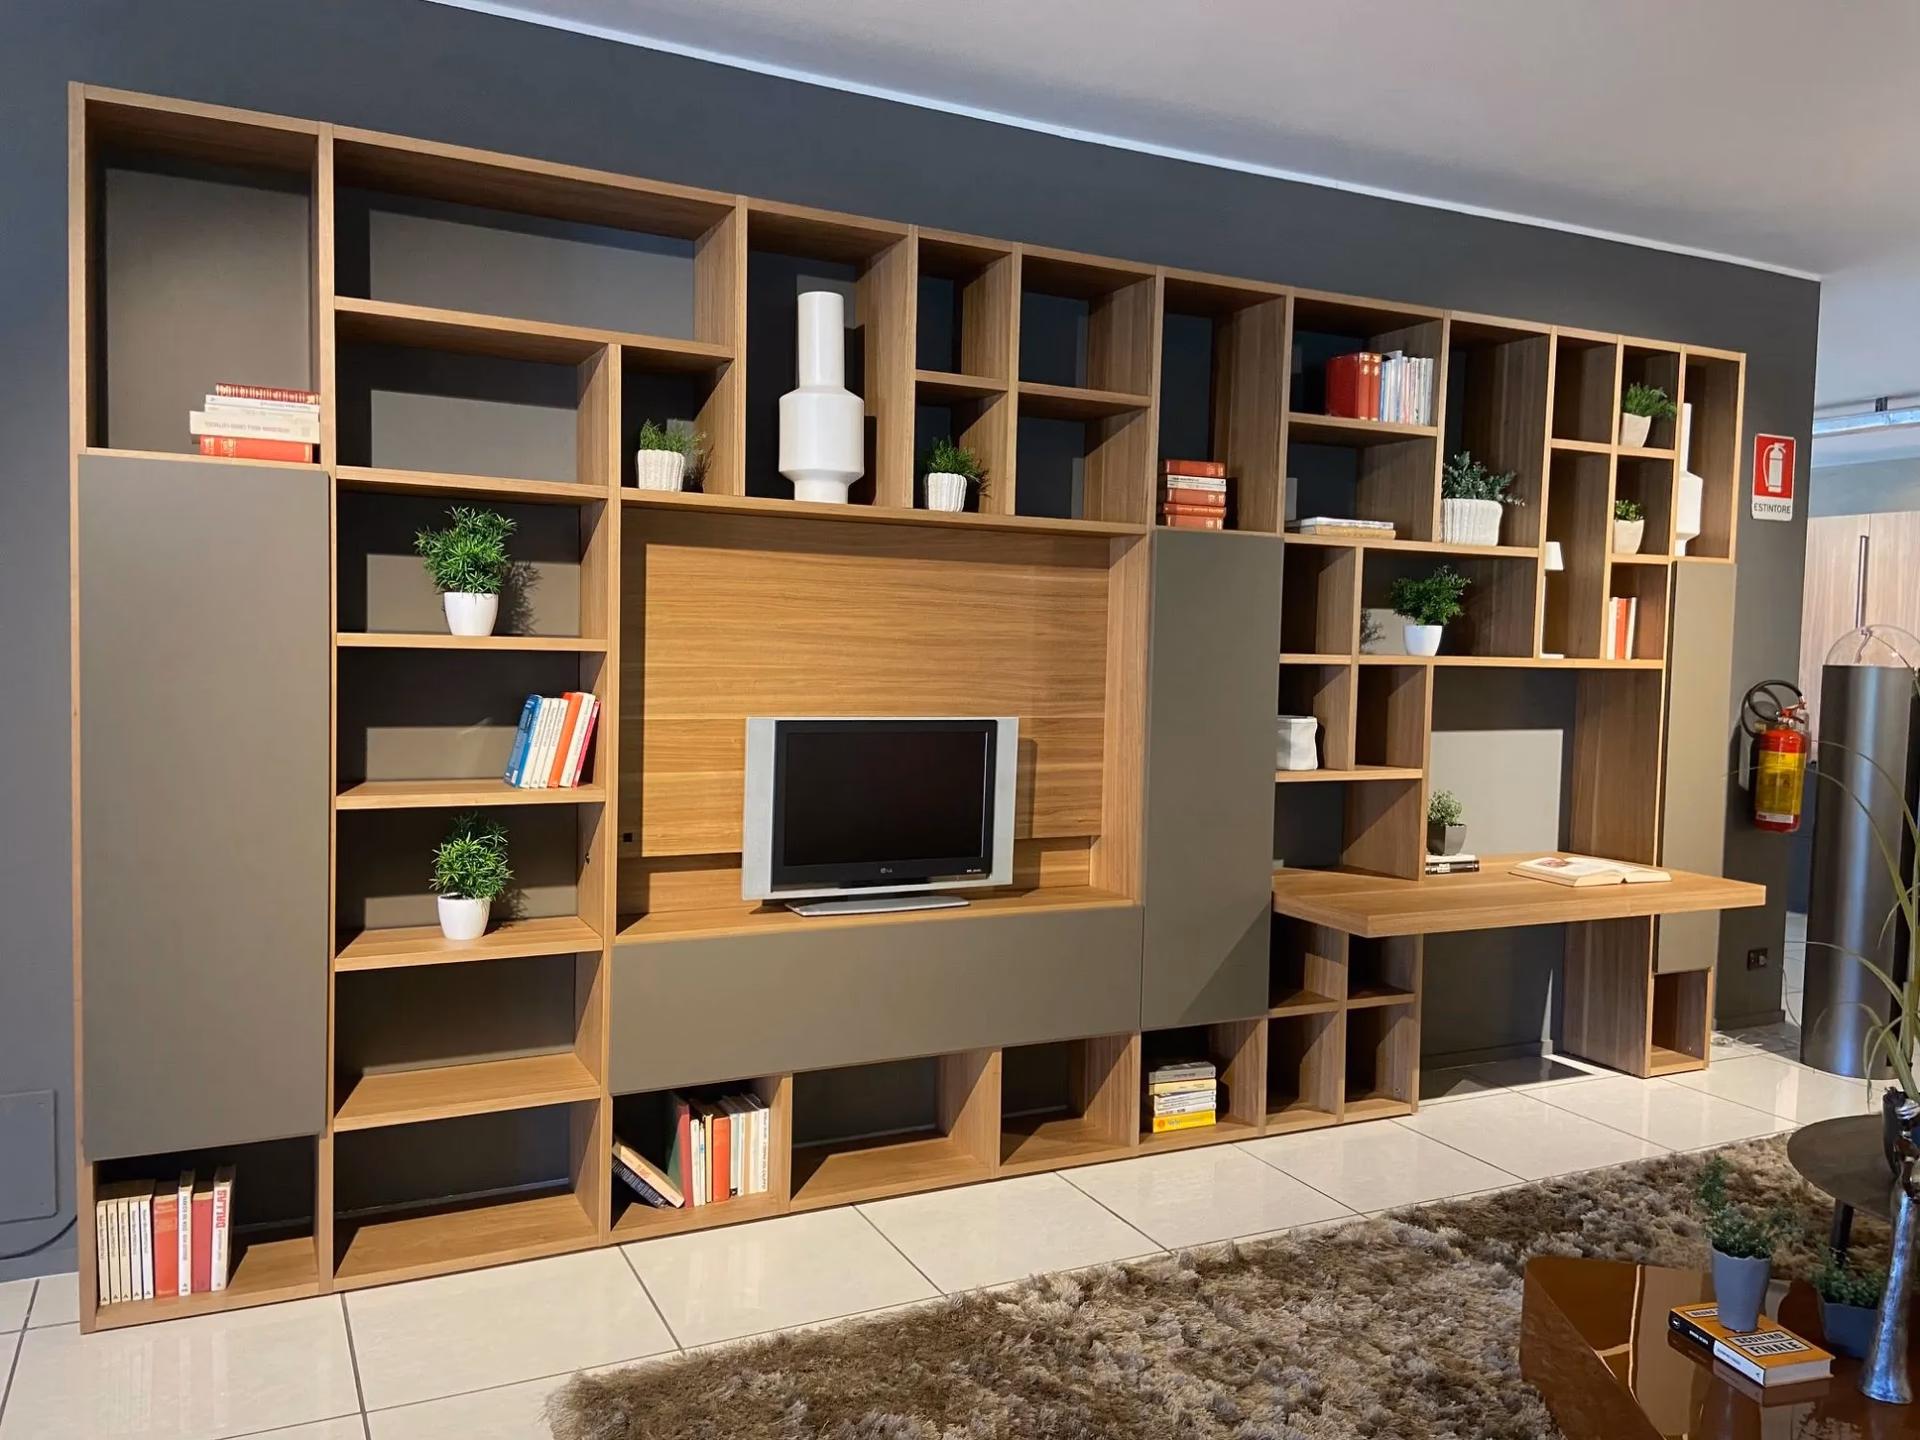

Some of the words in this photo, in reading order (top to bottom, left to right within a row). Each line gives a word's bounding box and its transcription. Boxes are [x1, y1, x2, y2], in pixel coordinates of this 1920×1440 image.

[1754, 502, 1791, 514] ESTINTORE
[216, 1189, 228, 1229] DALLAS
[1736, 1332, 1784, 1344] SCONTRO
[1749, 1341, 1802, 1354] FINALE
